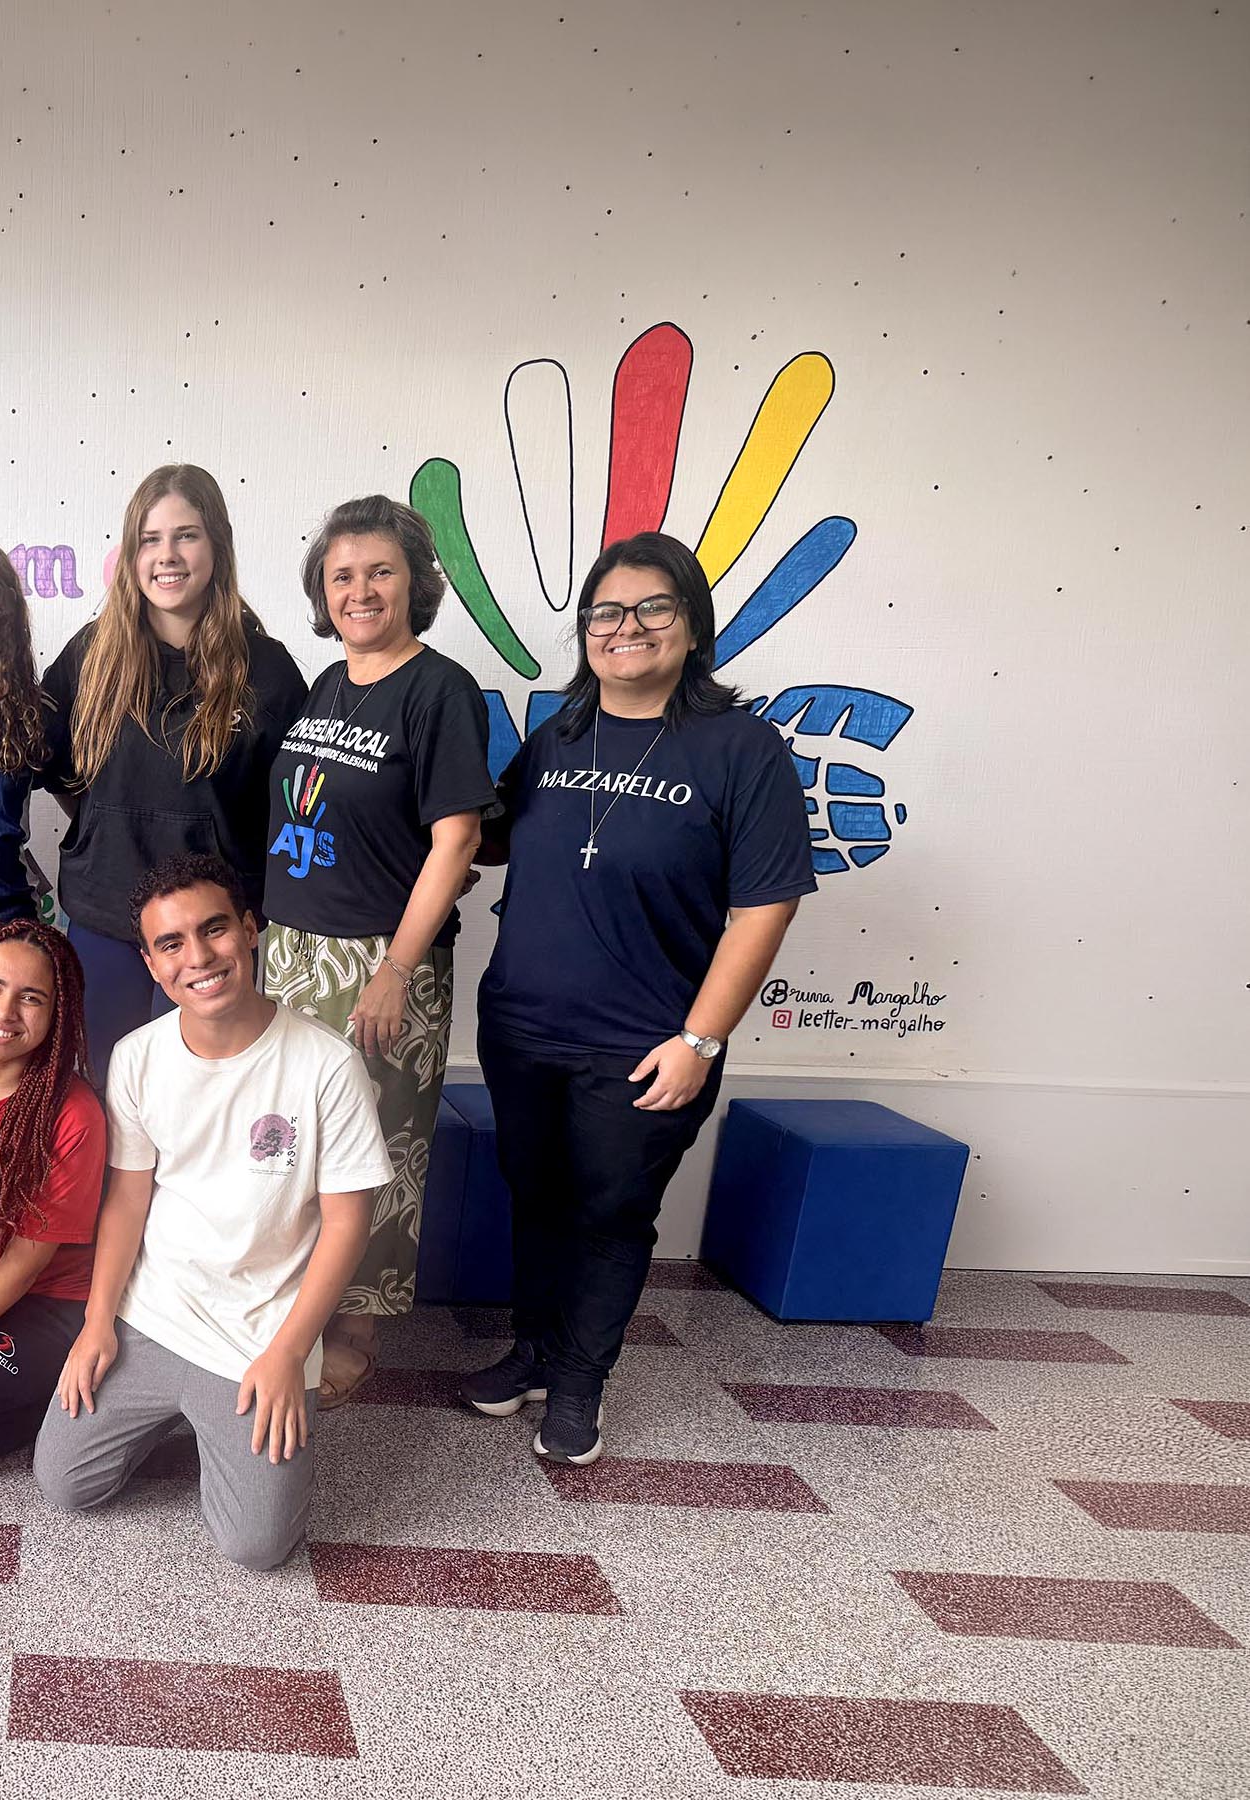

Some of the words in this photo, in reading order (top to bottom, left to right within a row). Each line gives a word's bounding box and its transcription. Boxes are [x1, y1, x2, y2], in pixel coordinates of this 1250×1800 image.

[338, 725, 390, 758] LOCAL
[336, 751, 379, 773] SALESIANA
[537, 769, 692, 805] MAZZARELLO
[268, 823, 337, 879] AJS
[760, 979, 834, 1007] Bruna
[847, 981, 947, 1017] Margalho
[798, 1009, 946, 1038] leetter_margalho
